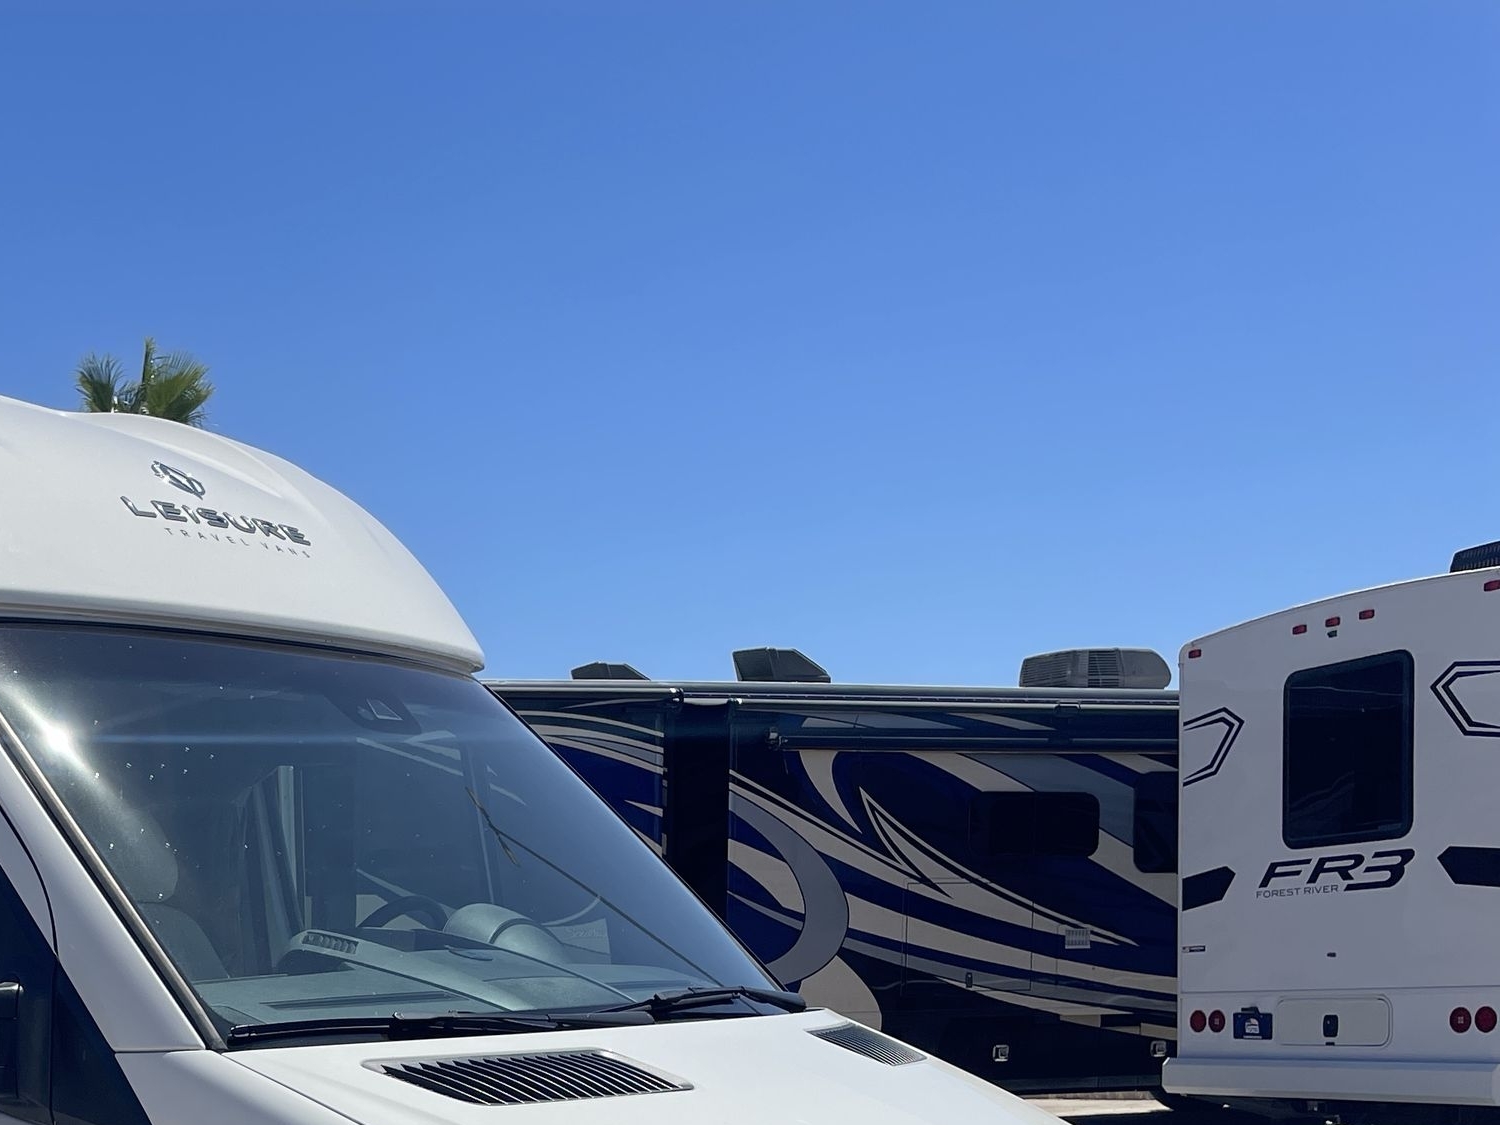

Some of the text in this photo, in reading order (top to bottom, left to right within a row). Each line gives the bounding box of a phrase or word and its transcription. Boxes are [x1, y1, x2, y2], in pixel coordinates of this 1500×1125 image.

[119, 495, 312, 547] LEISURE
[164, 527, 311, 558] TRAVEL VANS
[1258, 848, 1416, 892] FR3
[1256, 884, 1339, 899] FOREST RIVER
